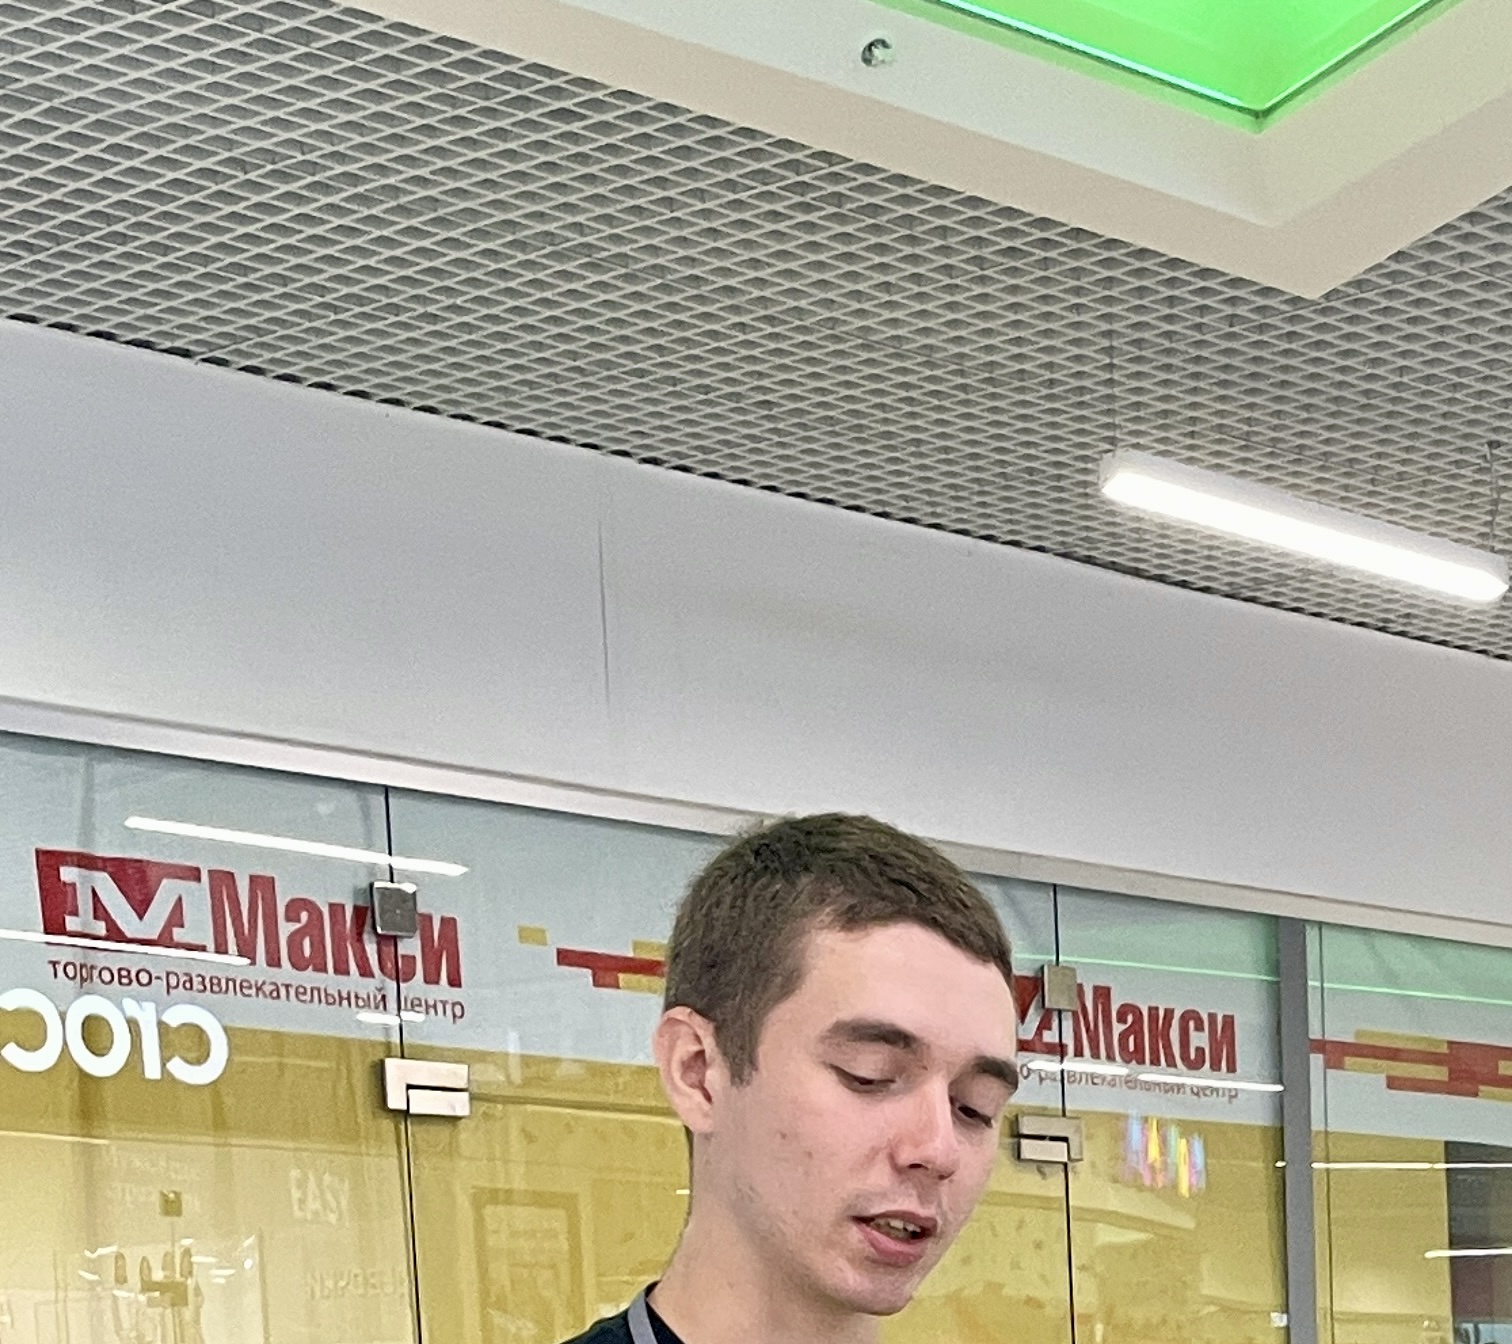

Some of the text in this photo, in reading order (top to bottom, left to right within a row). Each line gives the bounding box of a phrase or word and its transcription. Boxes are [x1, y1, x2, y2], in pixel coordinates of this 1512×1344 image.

[208, 869, 462, 987] Макси
[48, 959, 388, 1012] торгово-развлекательный
[1073, 983, 1238, 1074] Макси
